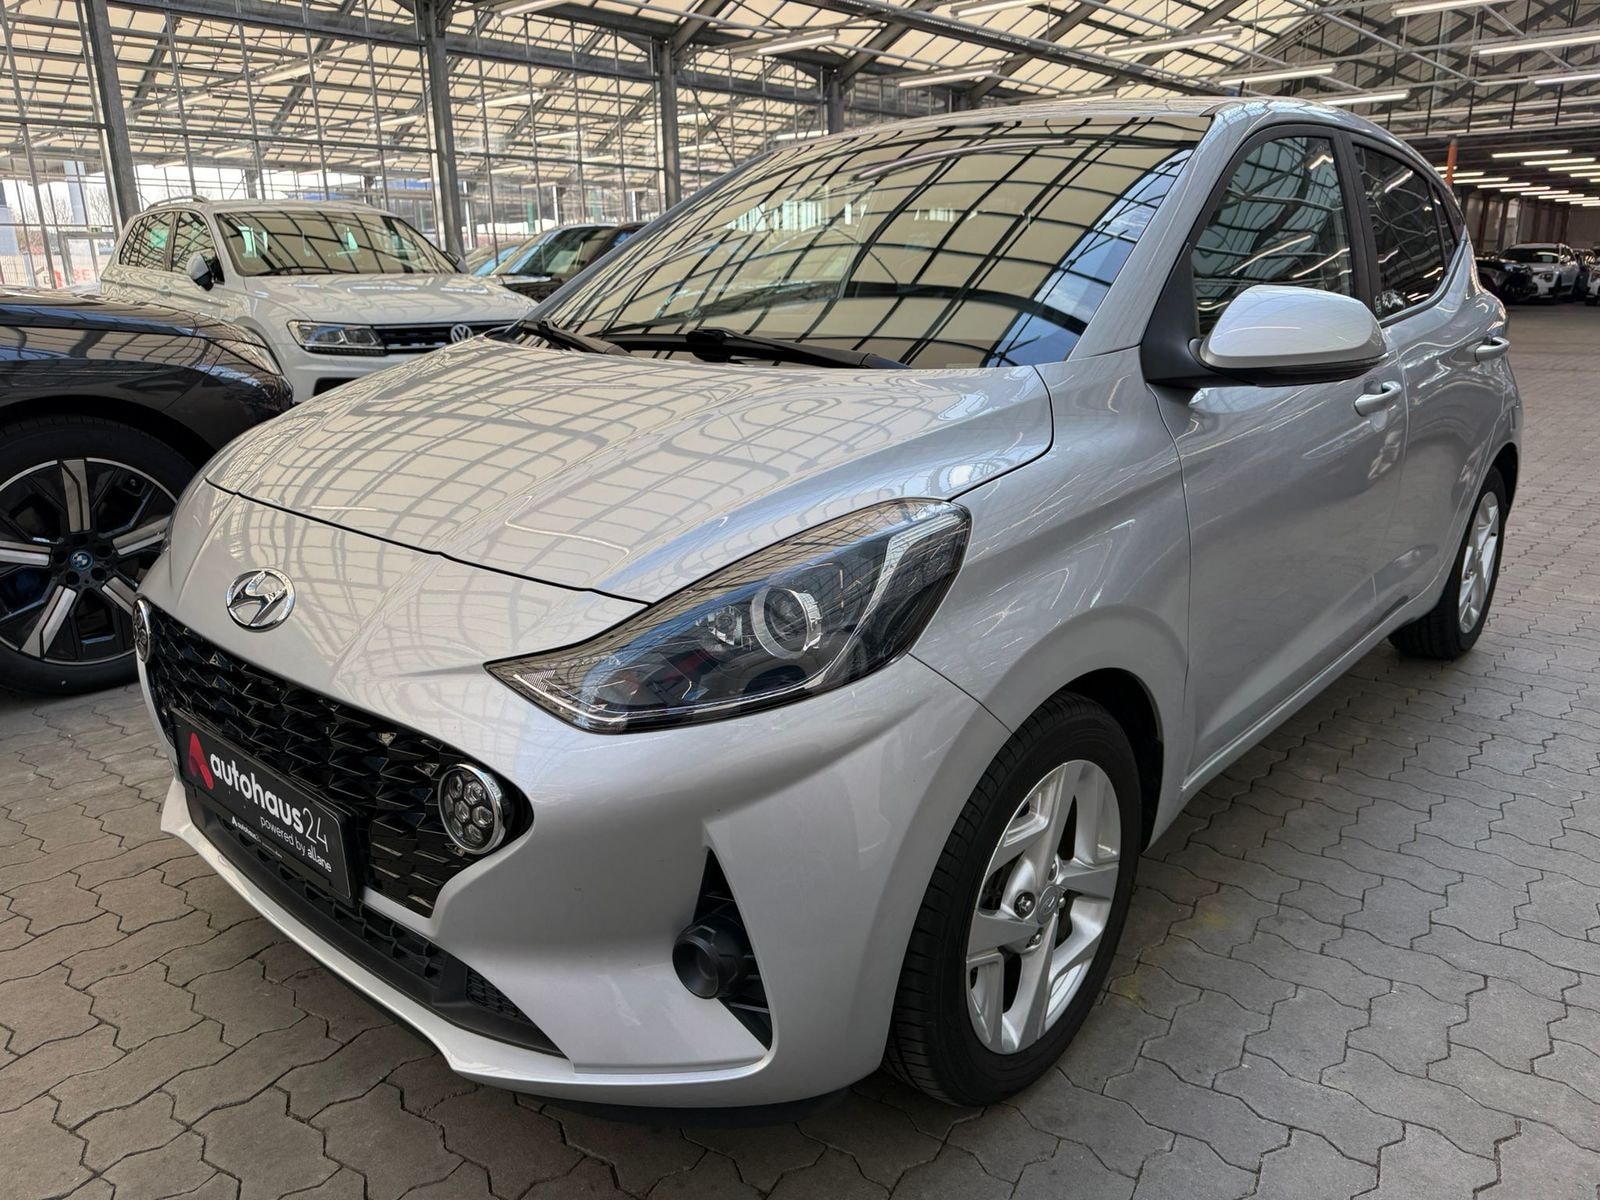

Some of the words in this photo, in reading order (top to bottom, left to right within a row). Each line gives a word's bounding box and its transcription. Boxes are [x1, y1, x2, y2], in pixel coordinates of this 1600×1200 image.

[210, 753, 329, 853] autohaus24
[260, 815, 295, 846] powered
[295, 836, 306, 856] by
[307, 844, 333, 873] allane
